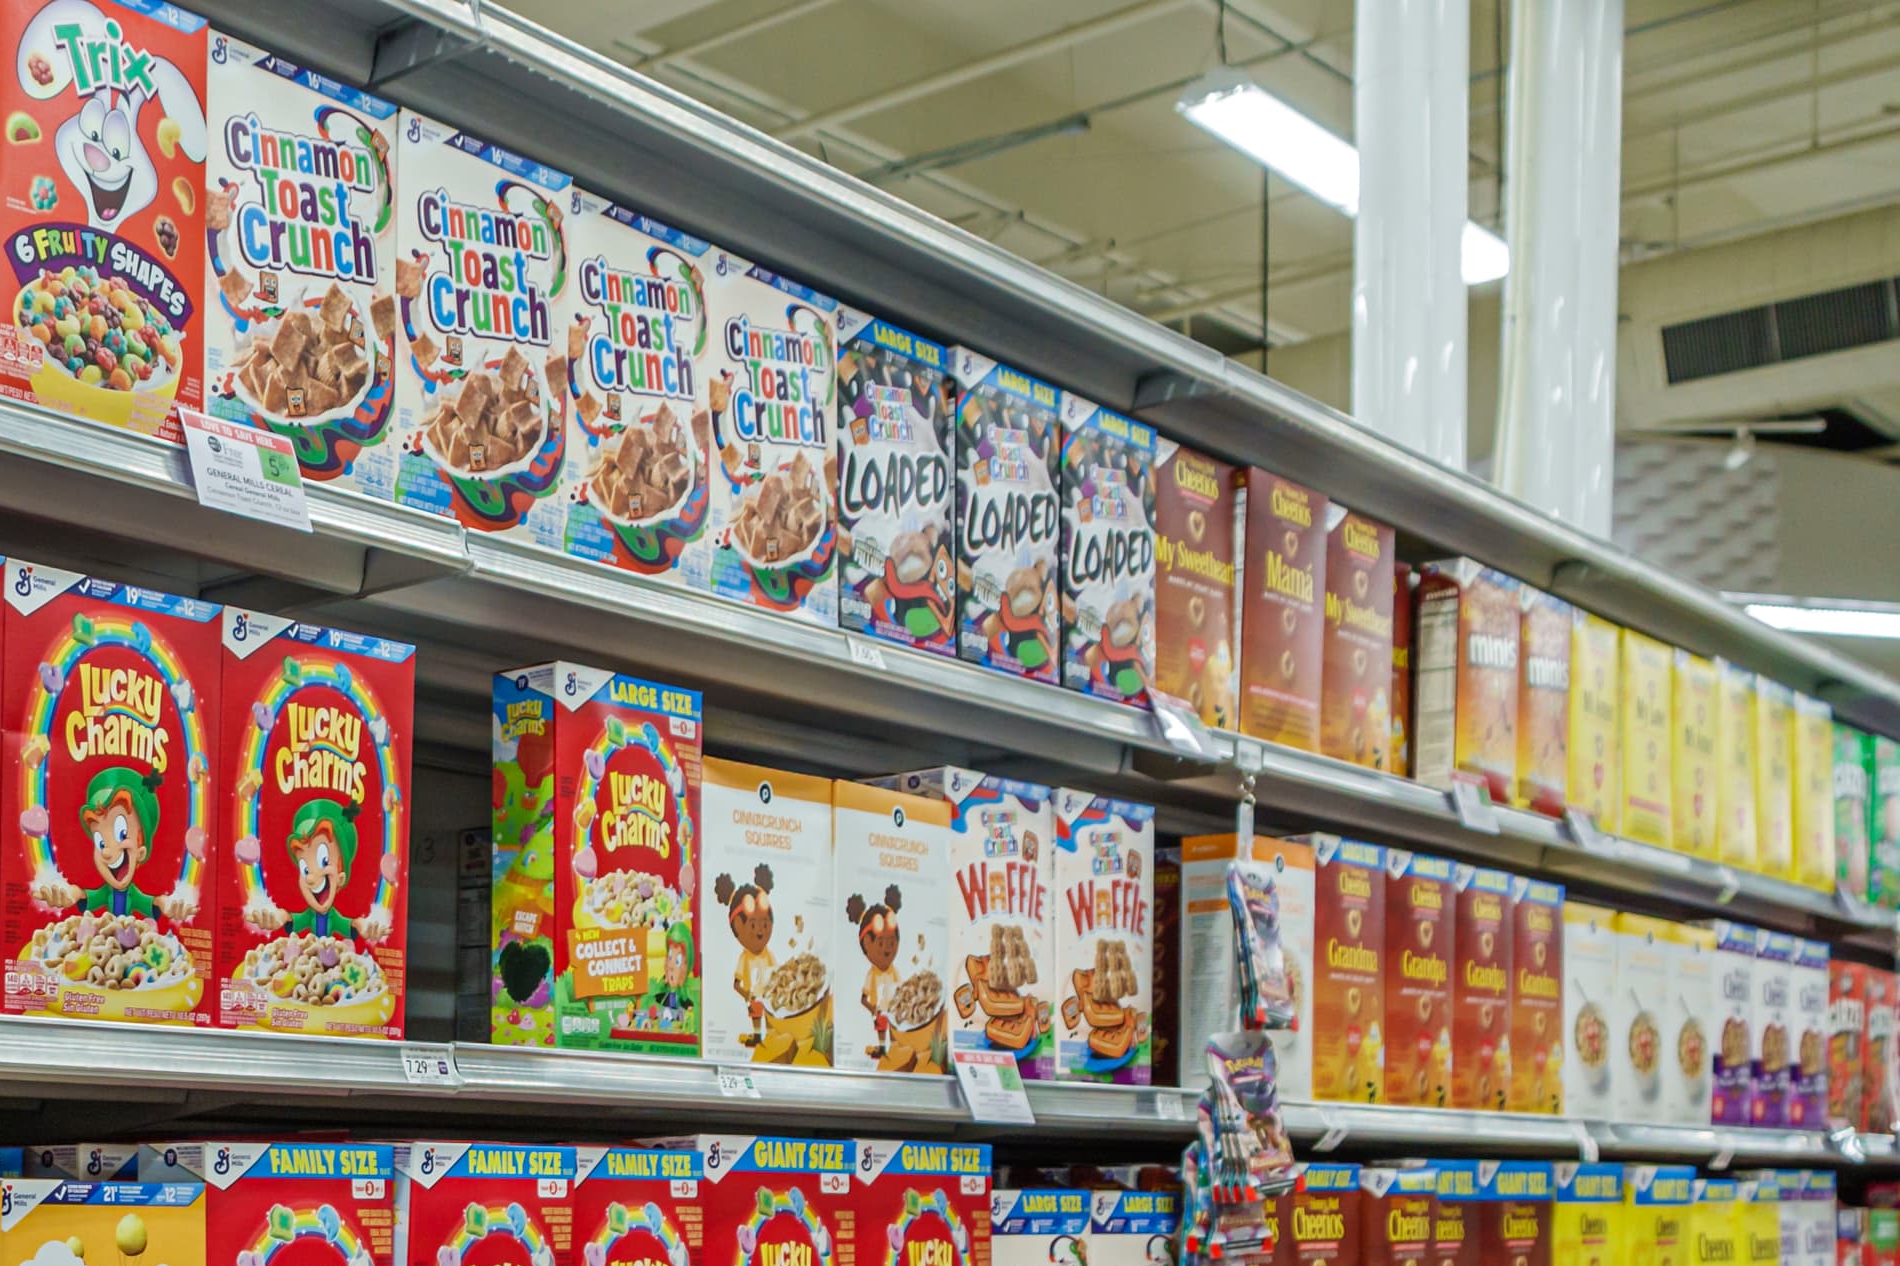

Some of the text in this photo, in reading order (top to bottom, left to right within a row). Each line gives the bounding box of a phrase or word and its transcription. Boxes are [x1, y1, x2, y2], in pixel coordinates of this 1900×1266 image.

[53, 17, 159, 99] Trix
[225, 110, 375, 190] Cinnamon
[259, 167, 351, 222] Toast
[237, 202, 378, 286] Crunch
[843, 453, 948, 515] LOADED
[965, 494, 1059, 551] LOADED
[609, 679, 693, 715] LARGE SIZE
[609, 770, 667, 825] Lucky
[732, 807, 802, 835] CINNACRUNCH
[601, 812, 671, 860] Charms
[744, 829, 793, 851] SQUARES
[270, 1148, 379, 1176] FAMILY SIZE
[754, 1142, 845, 1171] GIANT SIZE
[1292, 1208, 1344, 1240] Cheerios
